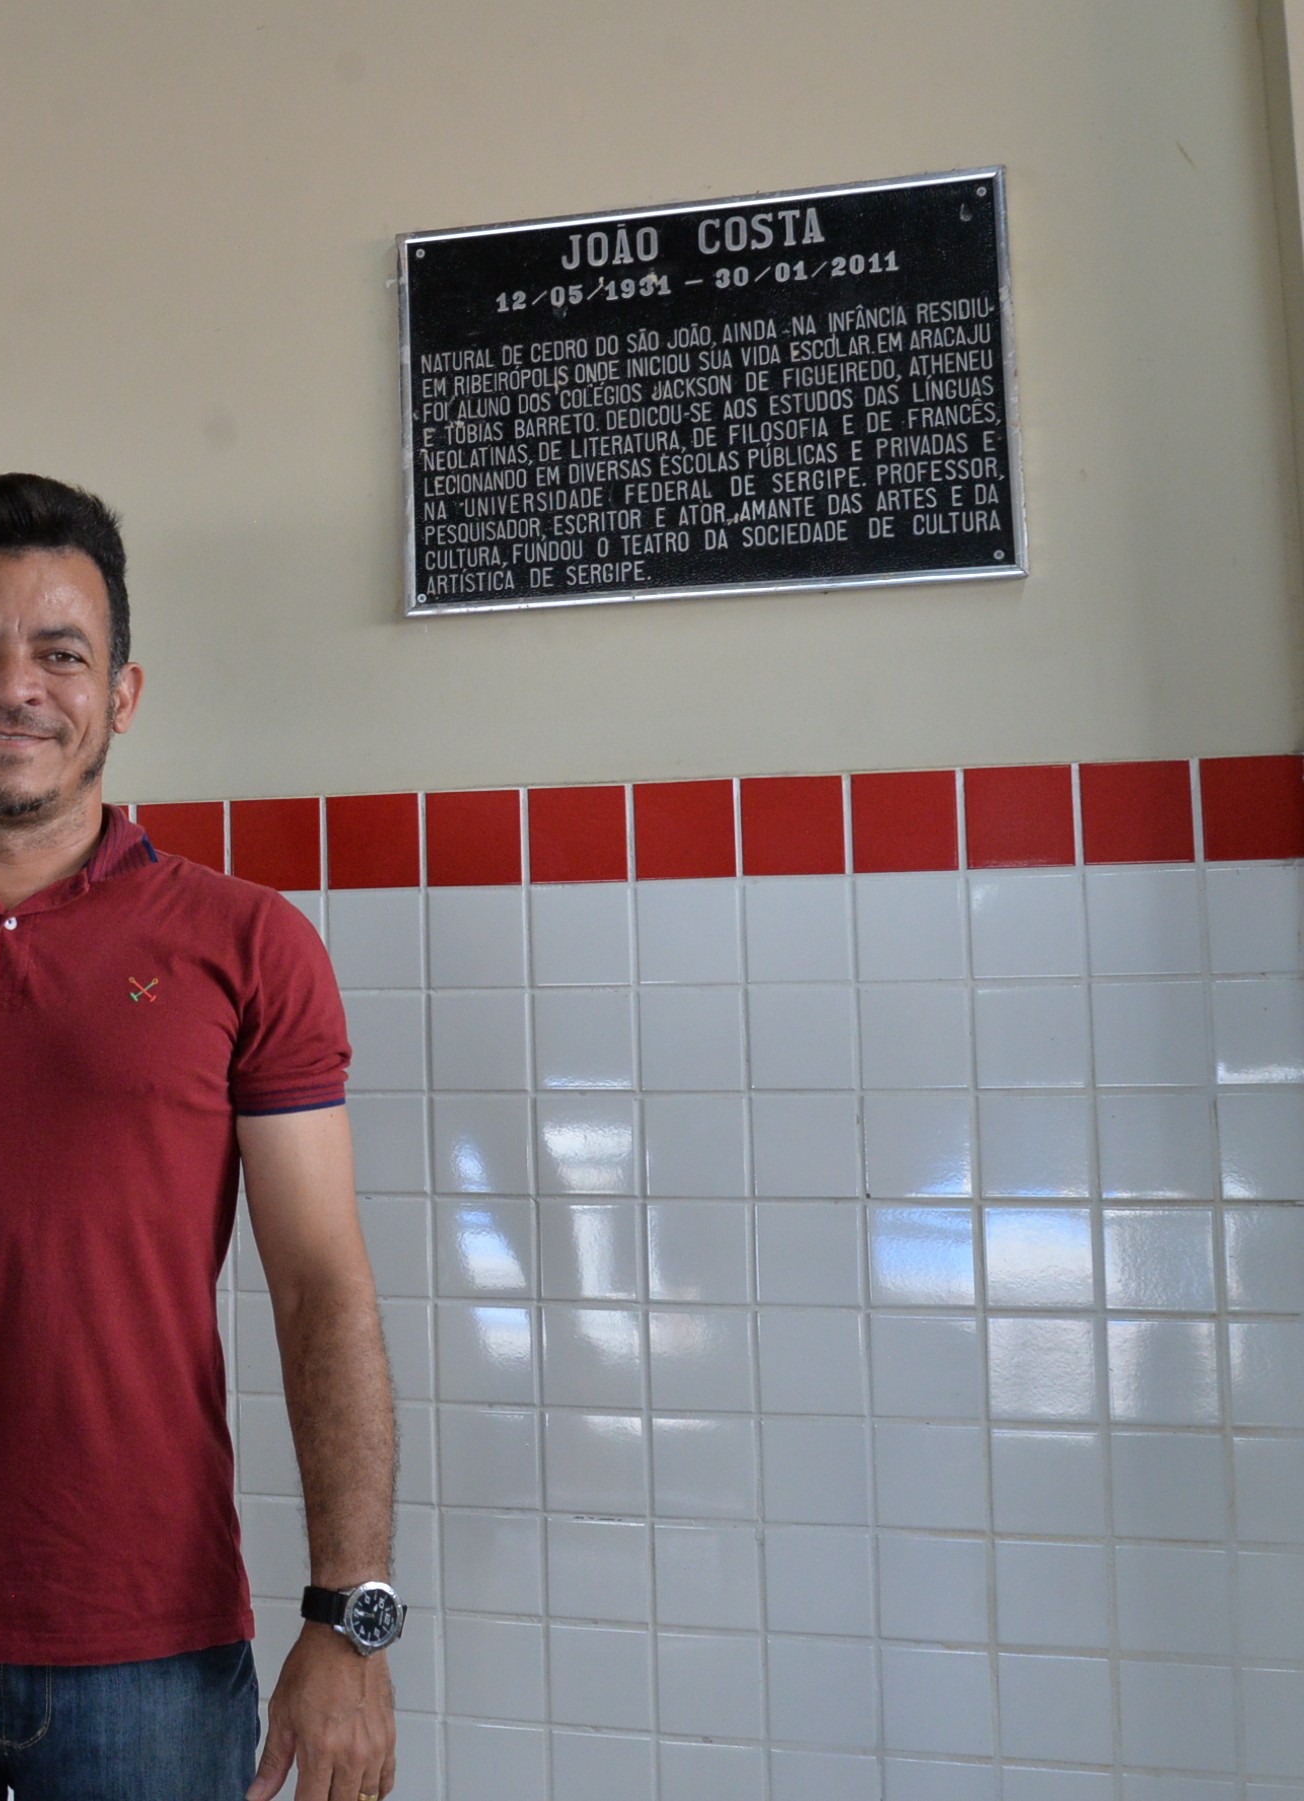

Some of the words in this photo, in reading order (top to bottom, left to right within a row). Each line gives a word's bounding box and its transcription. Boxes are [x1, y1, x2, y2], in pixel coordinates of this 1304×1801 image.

[562, 224, 658, 270] JOÃO
[697, 207, 825, 255] COSTA
[495, 274, 671, 312] 12/05/1931
[714, 249, 899, 289] 30/01/2011
[420, 347, 493, 374] NATURAL
[502, 344, 523, 366] DE
[530, 338, 587, 363] CEDRO
[595, 334, 618, 357] DO
[626, 326, 659, 353] SÃO
[666, 323, 717, 352] JOÃO,
[721, 317, 777, 343] AINDA
[828, 305, 907, 332] INFÂNCIA
[422, 377, 445, 398] EM
[454, 366, 569, 396] RIBEIRÓPOLIS
[574, 359, 620, 383] ONDE
[626, 352, 690, 378] INICIOU
[698, 347, 732, 371] SUA
[740, 343, 780, 367] VIDA
[908, 322, 991, 350] ARACAJU
[422, 400, 448, 422] FOI
[457, 394, 510, 419] ALUNO
[518, 391, 551, 414] DOS
[559, 382, 642, 409] COLÉGIOS
[651, 373, 732, 401] JACKSON
[745, 369, 769, 392] DE
[782, 359, 902, 389] FIGUEIREDO,
[908, 348, 993, 377] ATHENEU
[423, 427, 435, 447] E
[514, 411, 599, 439] BARRETO.
[606, 401, 712, 430] DEDICOU-SE
[722, 397, 757, 420] AOS
[769, 388, 853, 416] ESTUDOS
[864, 383, 899, 407] DAS
[911, 375, 994, 403] LÍNGUAS
[424, 444, 533, 471] NEOLATINAS,
[537, 439, 562, 462] DE
[570, 429, 686, 460] LITERATURA,
[692, 426, 717, 448] DE
[728, 415, 828, 445] FILOSOFIA
[841, 413, 854, 435] E
[865, 410, 892, 433] DE
[907, 400, 1002, 431] FRANCÊS,
[424, 468, 526, 497] LECIONANDO
[536, 465, 560, 487] EM
[568, 457, 651, 484] DIVERSAS
[659, 449, 739, 477] ESCOLAS
[747, 442, 837, 468] PÚBLICAS
[850, 439, 863, 461] E
[875, 431, 968, 460] PRIVADAS
[982, 430, 996, 452] E
[423, 500, 447, 521] NA
[464, 486, 603, 518] UNIVERSIDADE
[624, 477, 712, 505] FEDERAL
[730, 474, 756, 497] DE
[771, 465, 866, 494] SERGIPE.
[875, 456, 1005, 486] PROFESSOR,
[424, 517, 546, 545] PESQUISADOR,
[552, 508, 641, 536] ESCRITOR
[655, 506, 667, 528] E
[739, 495, 815, 522] AMANTE
[827, 492, 863, 516] DAS
[874, 486, 937, 513] ARTES
[950, 484, 963, 507] E
[974, 482, 999, 505] DA
[425, 545, 507, 571] CULTURA,
[512, 538, 583, 564] FUNDOU
[597, 536, 609, 558] O
[620, 530, 689, 556] TEATRO
[704, 527, 728, 551] DA
[741, 518, 848, 548] SOCIEDADE
[868, 515, 895, 539] DE
[911, 507, 1001, 537] CULTURA
[426, 568, 515, 596] ARTÍSTICA
[530, 566, 554, 588] DE
[565, 559, 651, 586] SERGIPE.
